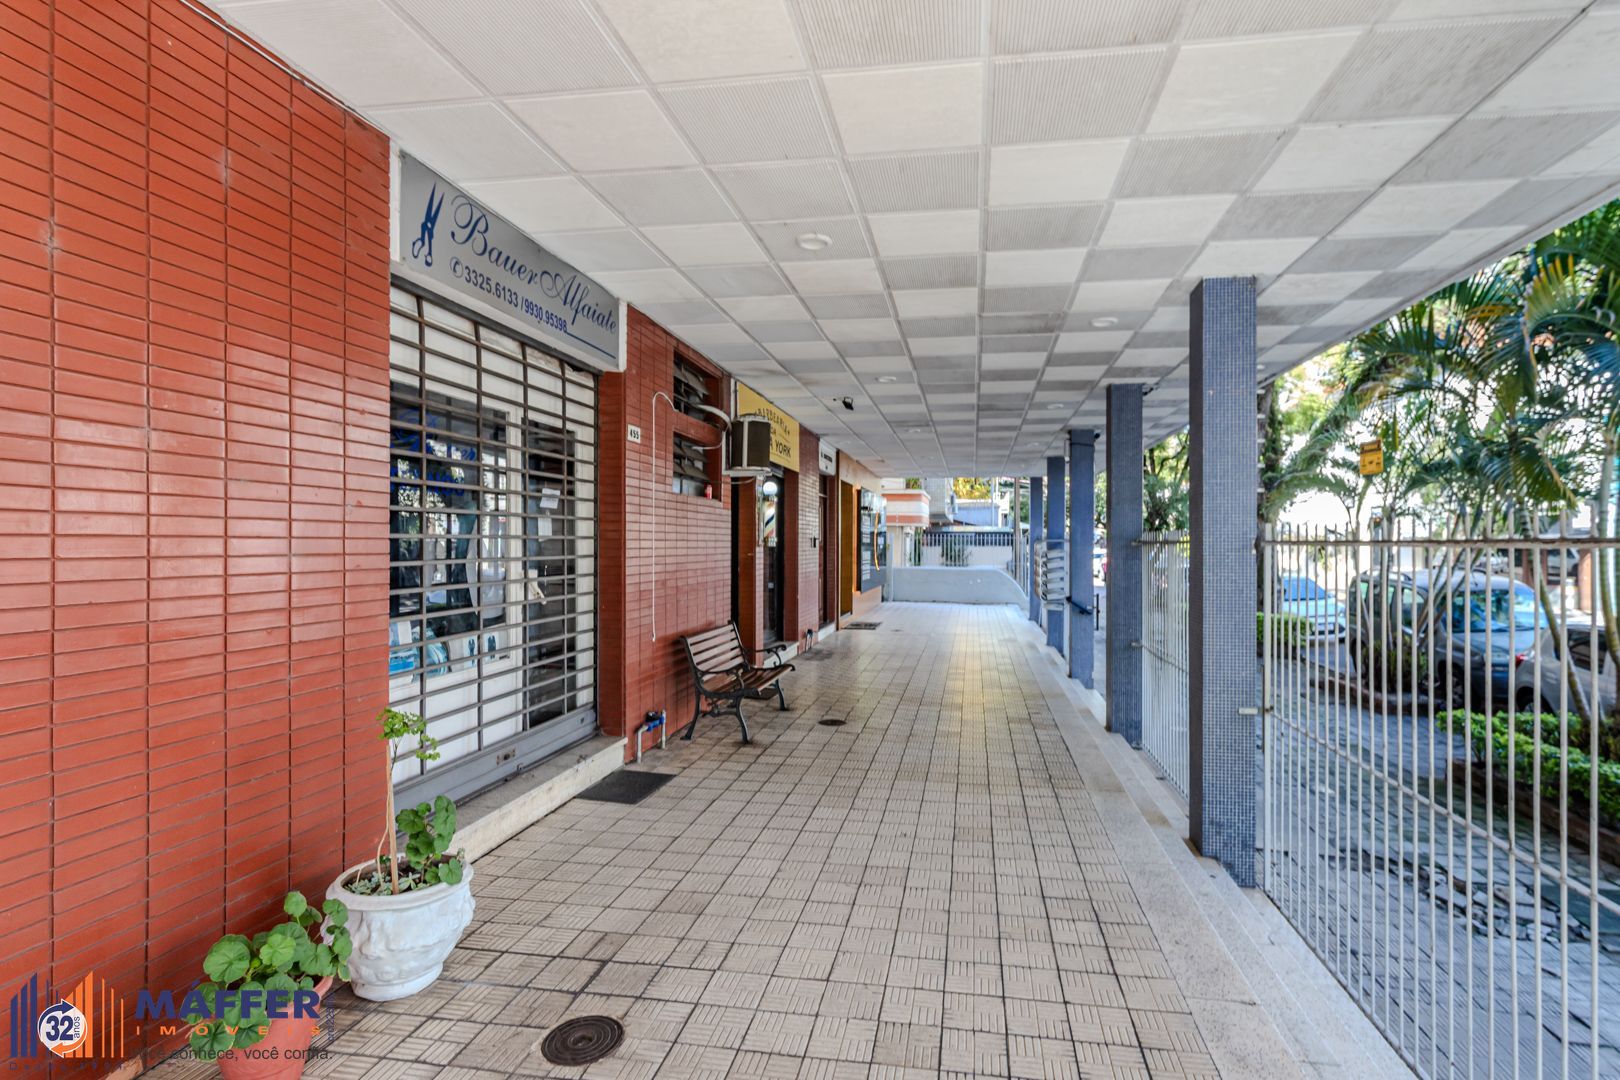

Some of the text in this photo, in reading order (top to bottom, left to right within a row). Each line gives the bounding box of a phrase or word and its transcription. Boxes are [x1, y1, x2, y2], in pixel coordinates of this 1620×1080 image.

[450, 194, 617, 334] Bauer Alfaiate
[775, 439, 791, 458] YORK
